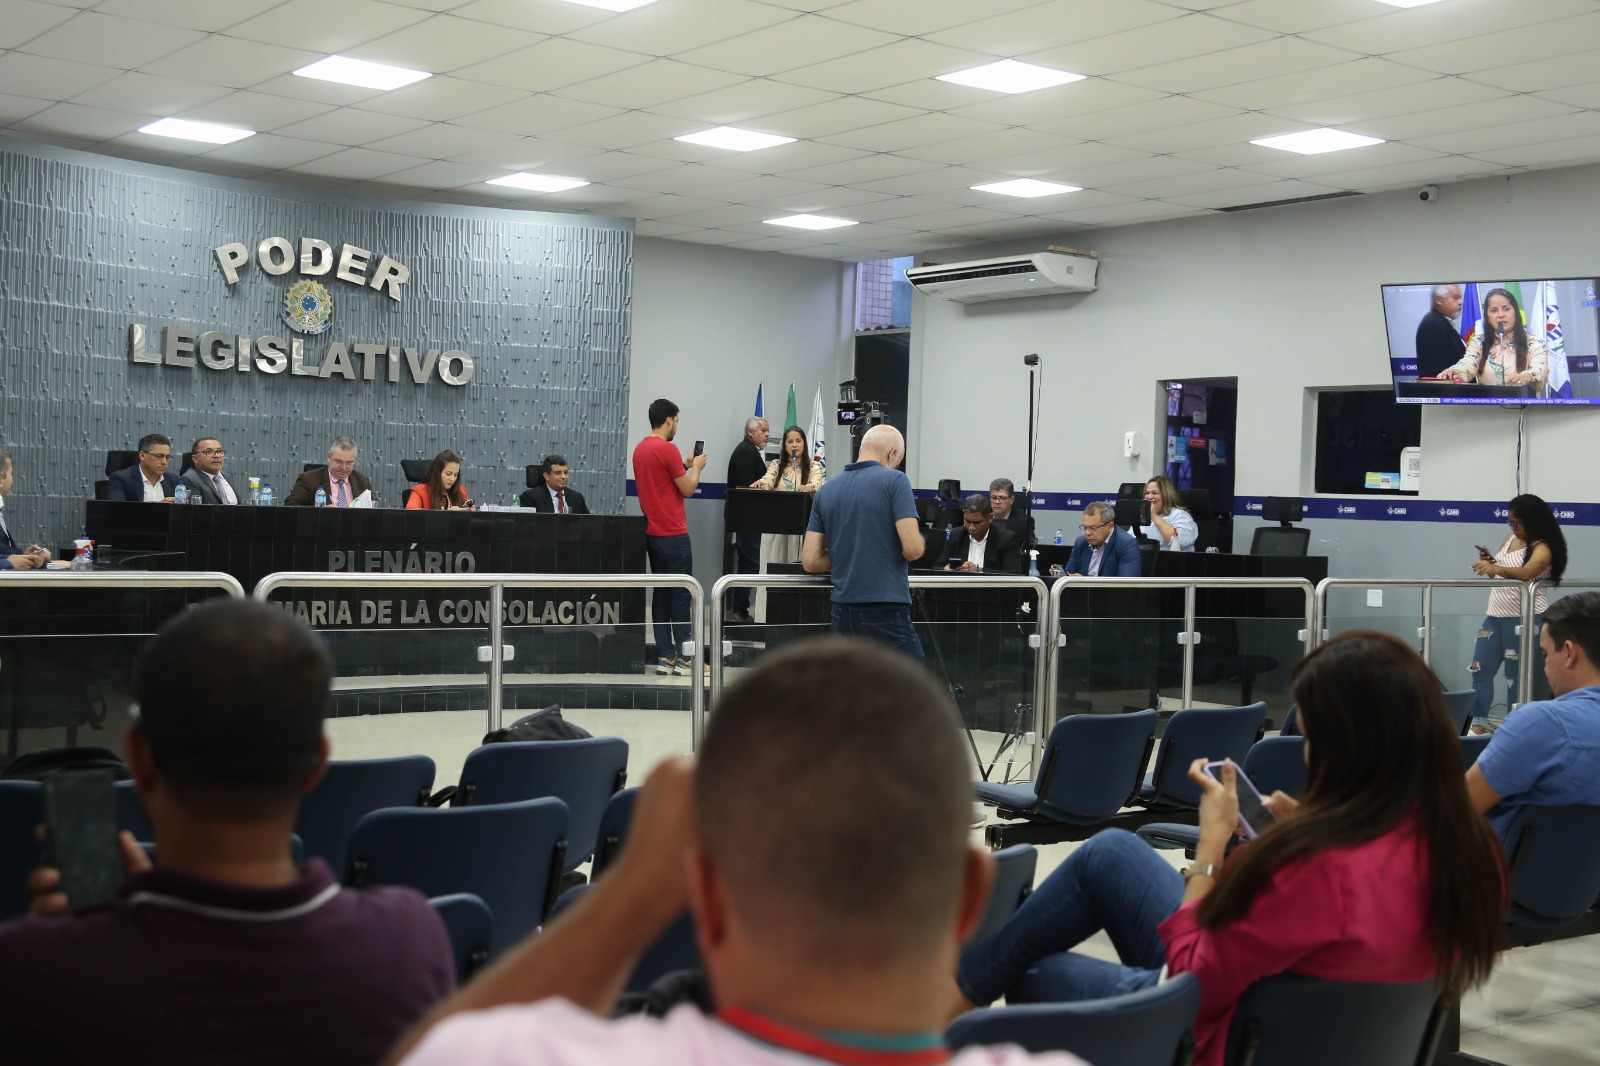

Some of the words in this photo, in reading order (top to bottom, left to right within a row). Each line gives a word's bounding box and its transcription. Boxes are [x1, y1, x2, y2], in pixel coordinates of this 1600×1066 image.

[213, 236, 410, 302] PODER
[129, 323, 474, 387] LEGISLATIVO
[360, 600, 392, 625] DE
[400, 600, 430, 624] LA
